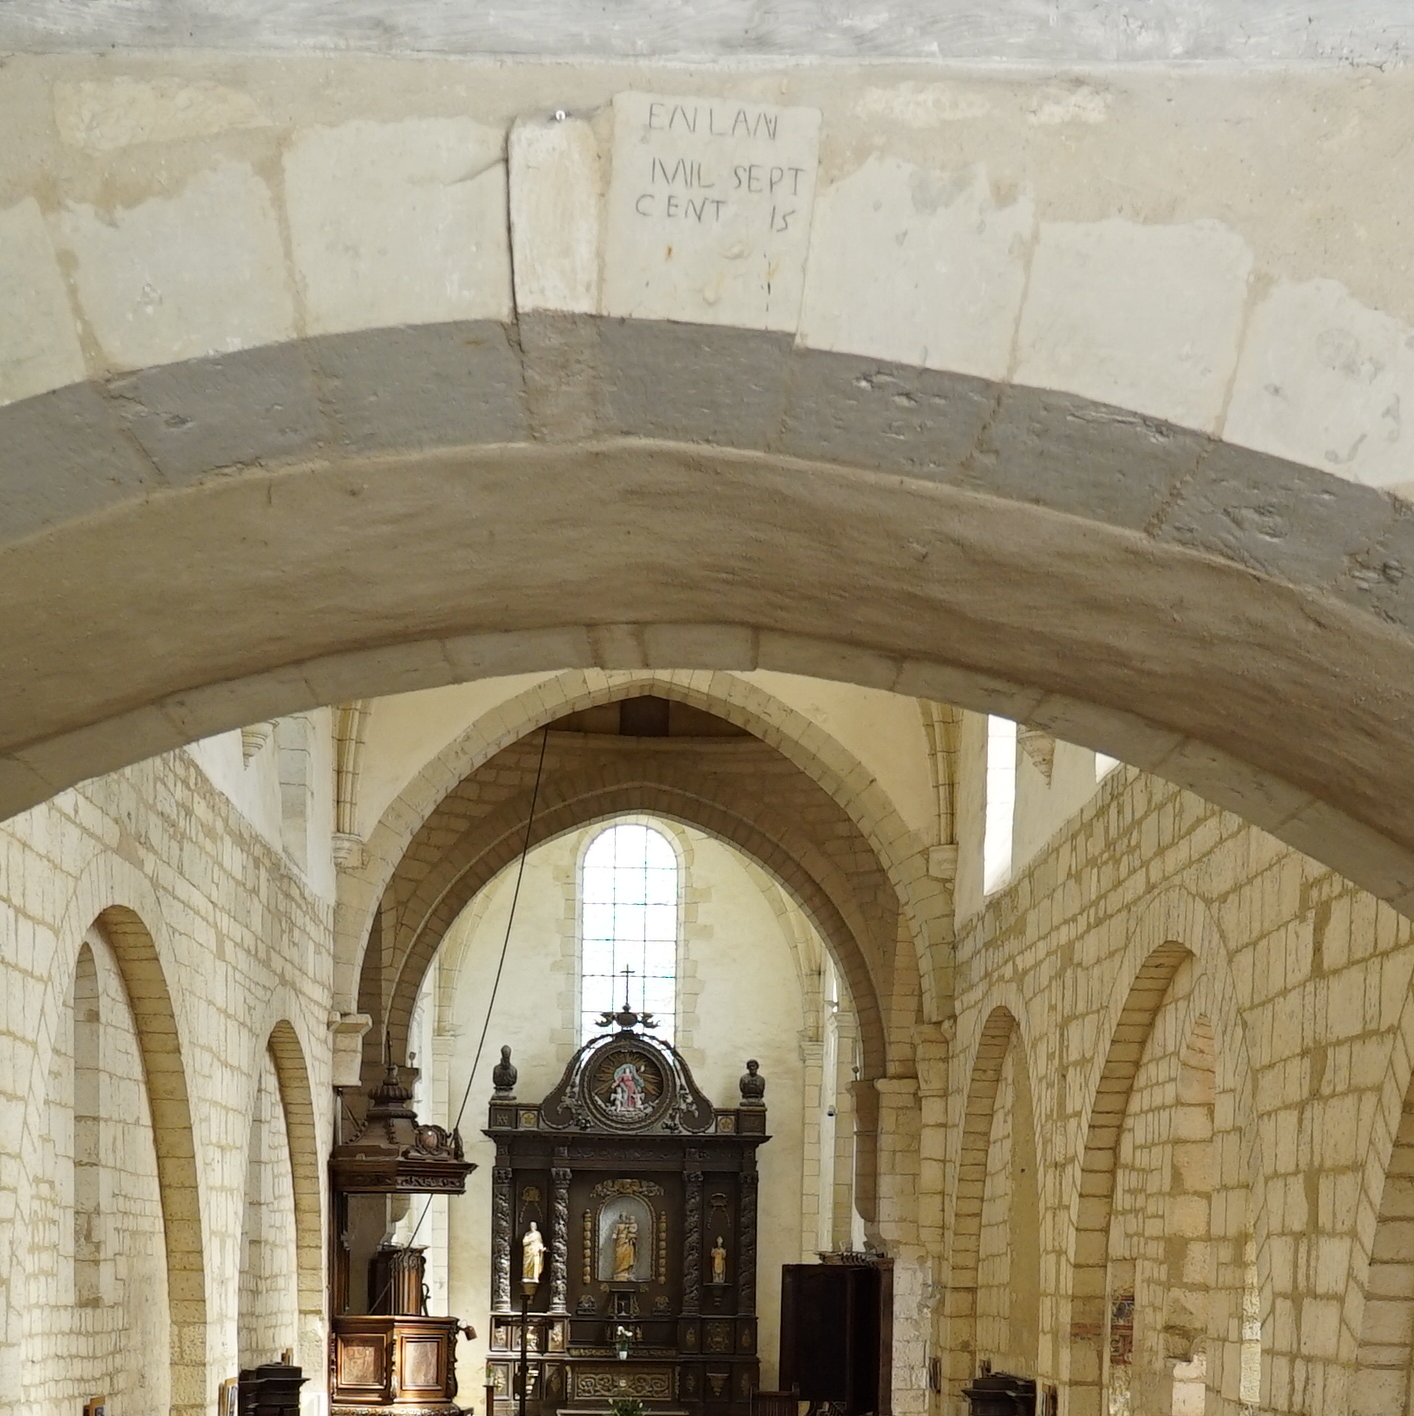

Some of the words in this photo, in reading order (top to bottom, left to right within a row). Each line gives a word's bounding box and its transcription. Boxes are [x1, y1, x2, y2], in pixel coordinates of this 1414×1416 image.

[648, 102, 698, 133] EN
[709, 107, 778, 140] LAN
[651, 157, 715, 189] MIL
[733, 164, 806, 196] SEPT
[635, 193, 727, 223] CENT
